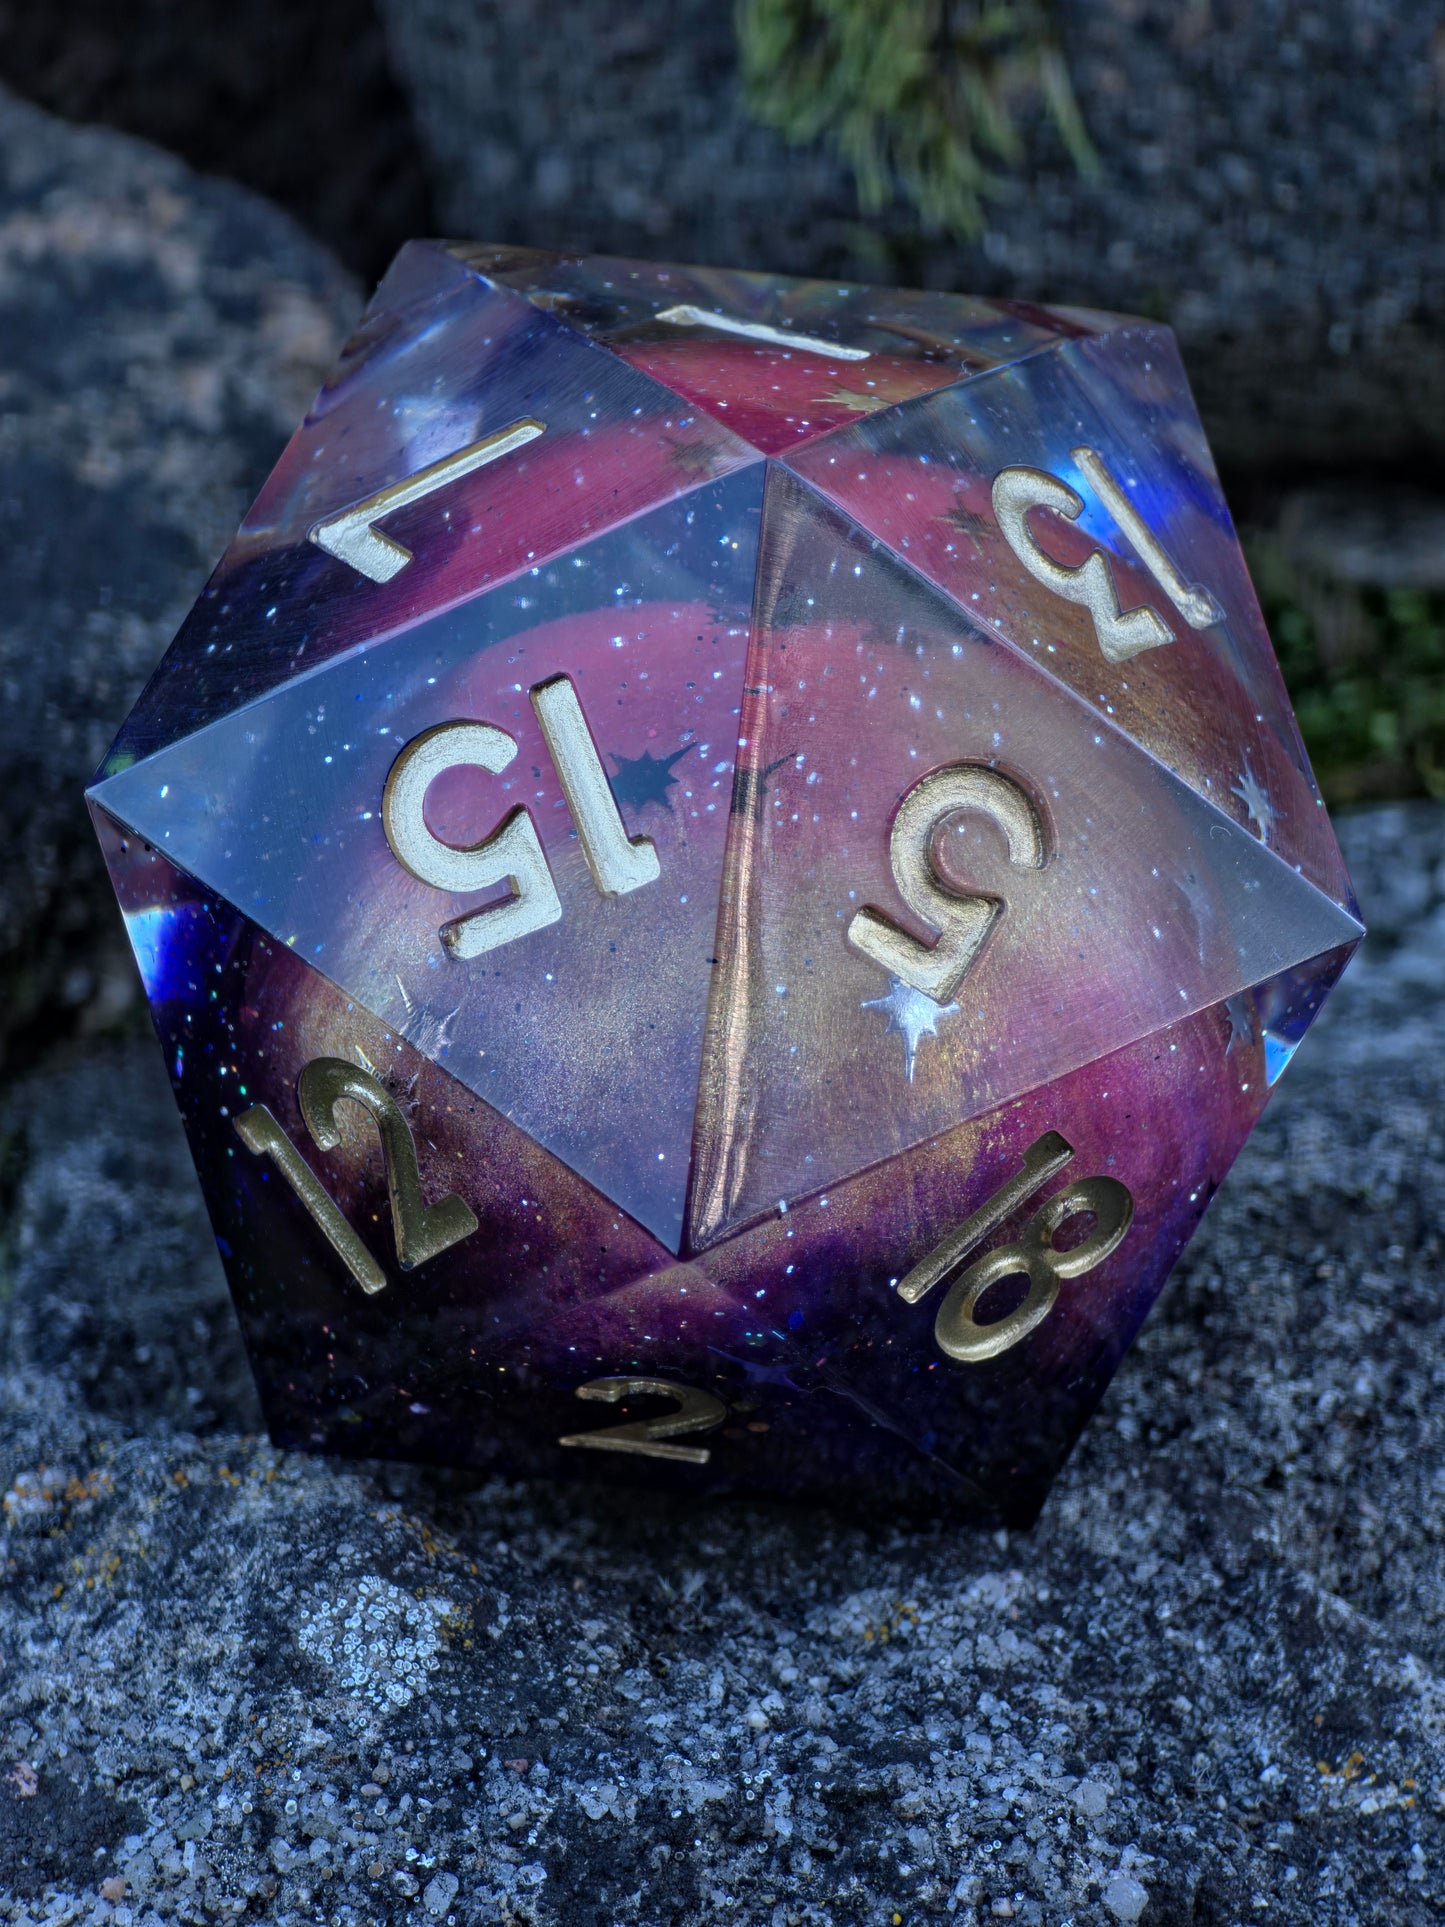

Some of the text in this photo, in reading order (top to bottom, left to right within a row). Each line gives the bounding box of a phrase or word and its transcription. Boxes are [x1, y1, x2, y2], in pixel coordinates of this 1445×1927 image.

[991, 445, 1227, 664] 13
[381, 671, 661, 962] 15
[847, 757, 1055, 1006] 5
[232, 1057, 479, 1295] 12
[896, 1130, 1134, 1362] 18
[558, 1376, 726, 1464] 2
